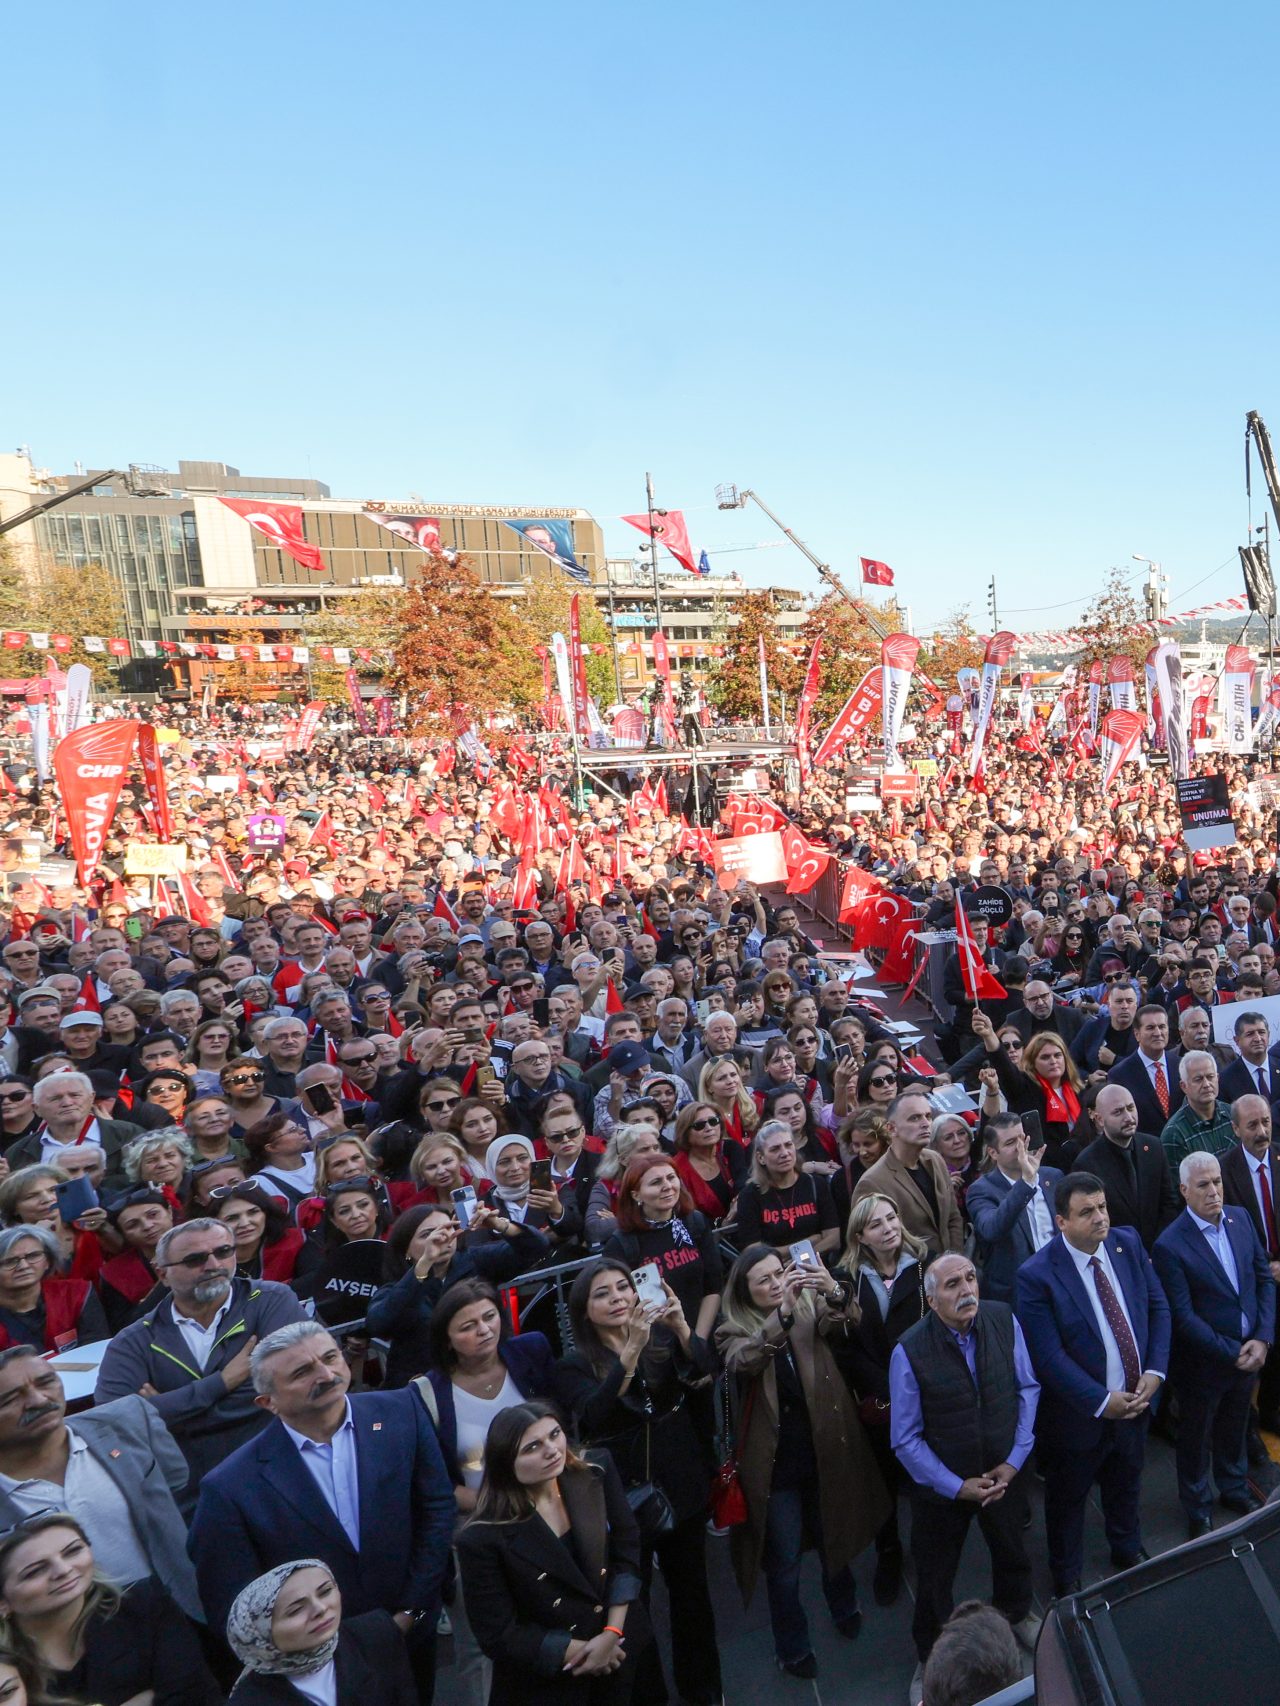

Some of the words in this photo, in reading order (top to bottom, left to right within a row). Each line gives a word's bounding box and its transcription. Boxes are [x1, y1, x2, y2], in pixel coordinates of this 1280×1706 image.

[862, 686, 881, 699] CHP
[1235, 684, 1245, 712] FATİH
[1235, 714, 1245, 742] CHP
[77, 763, 123, 778] CHP
[1192, 808, 1230, 822] UNUTMA!
[977, 897, 1004, 905] ZAHİDE
[979, 905, 1004, 914] GÜÇLÜ
